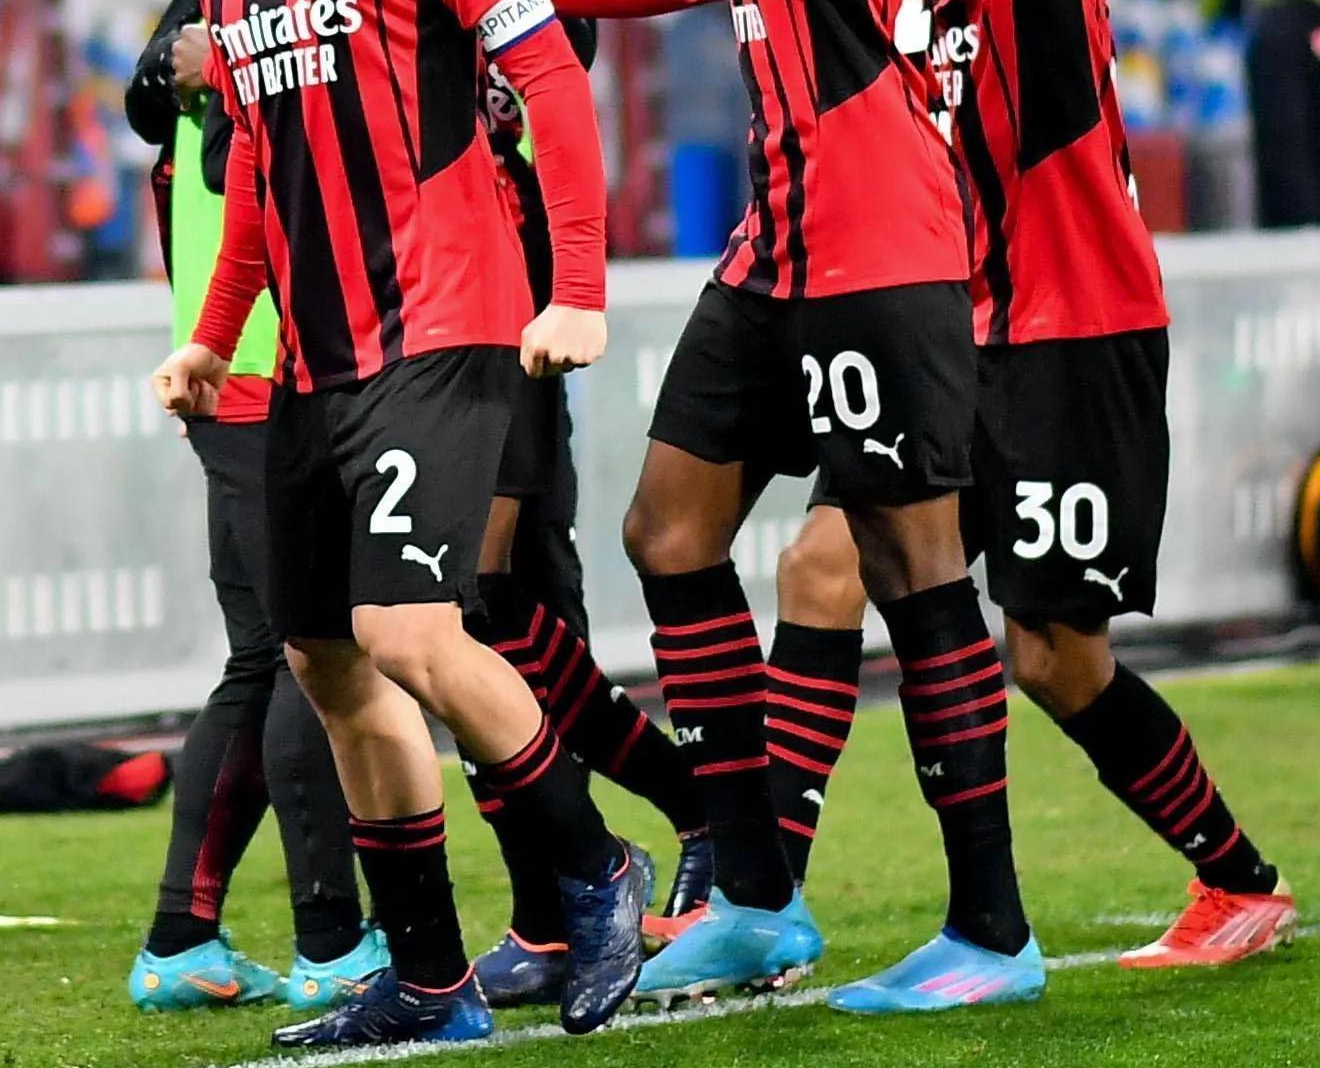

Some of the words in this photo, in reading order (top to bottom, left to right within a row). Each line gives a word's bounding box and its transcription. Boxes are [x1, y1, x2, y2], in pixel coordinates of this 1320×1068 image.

[233, 63, 260, 106] FLY
[260, 44, 338, 96] BETTER
[801, 350, 881, 434] 20
[369, 449, 417, 534] 2
[1012, 480, 1108, 560] 30
[675, 726, 704, 747] CM
